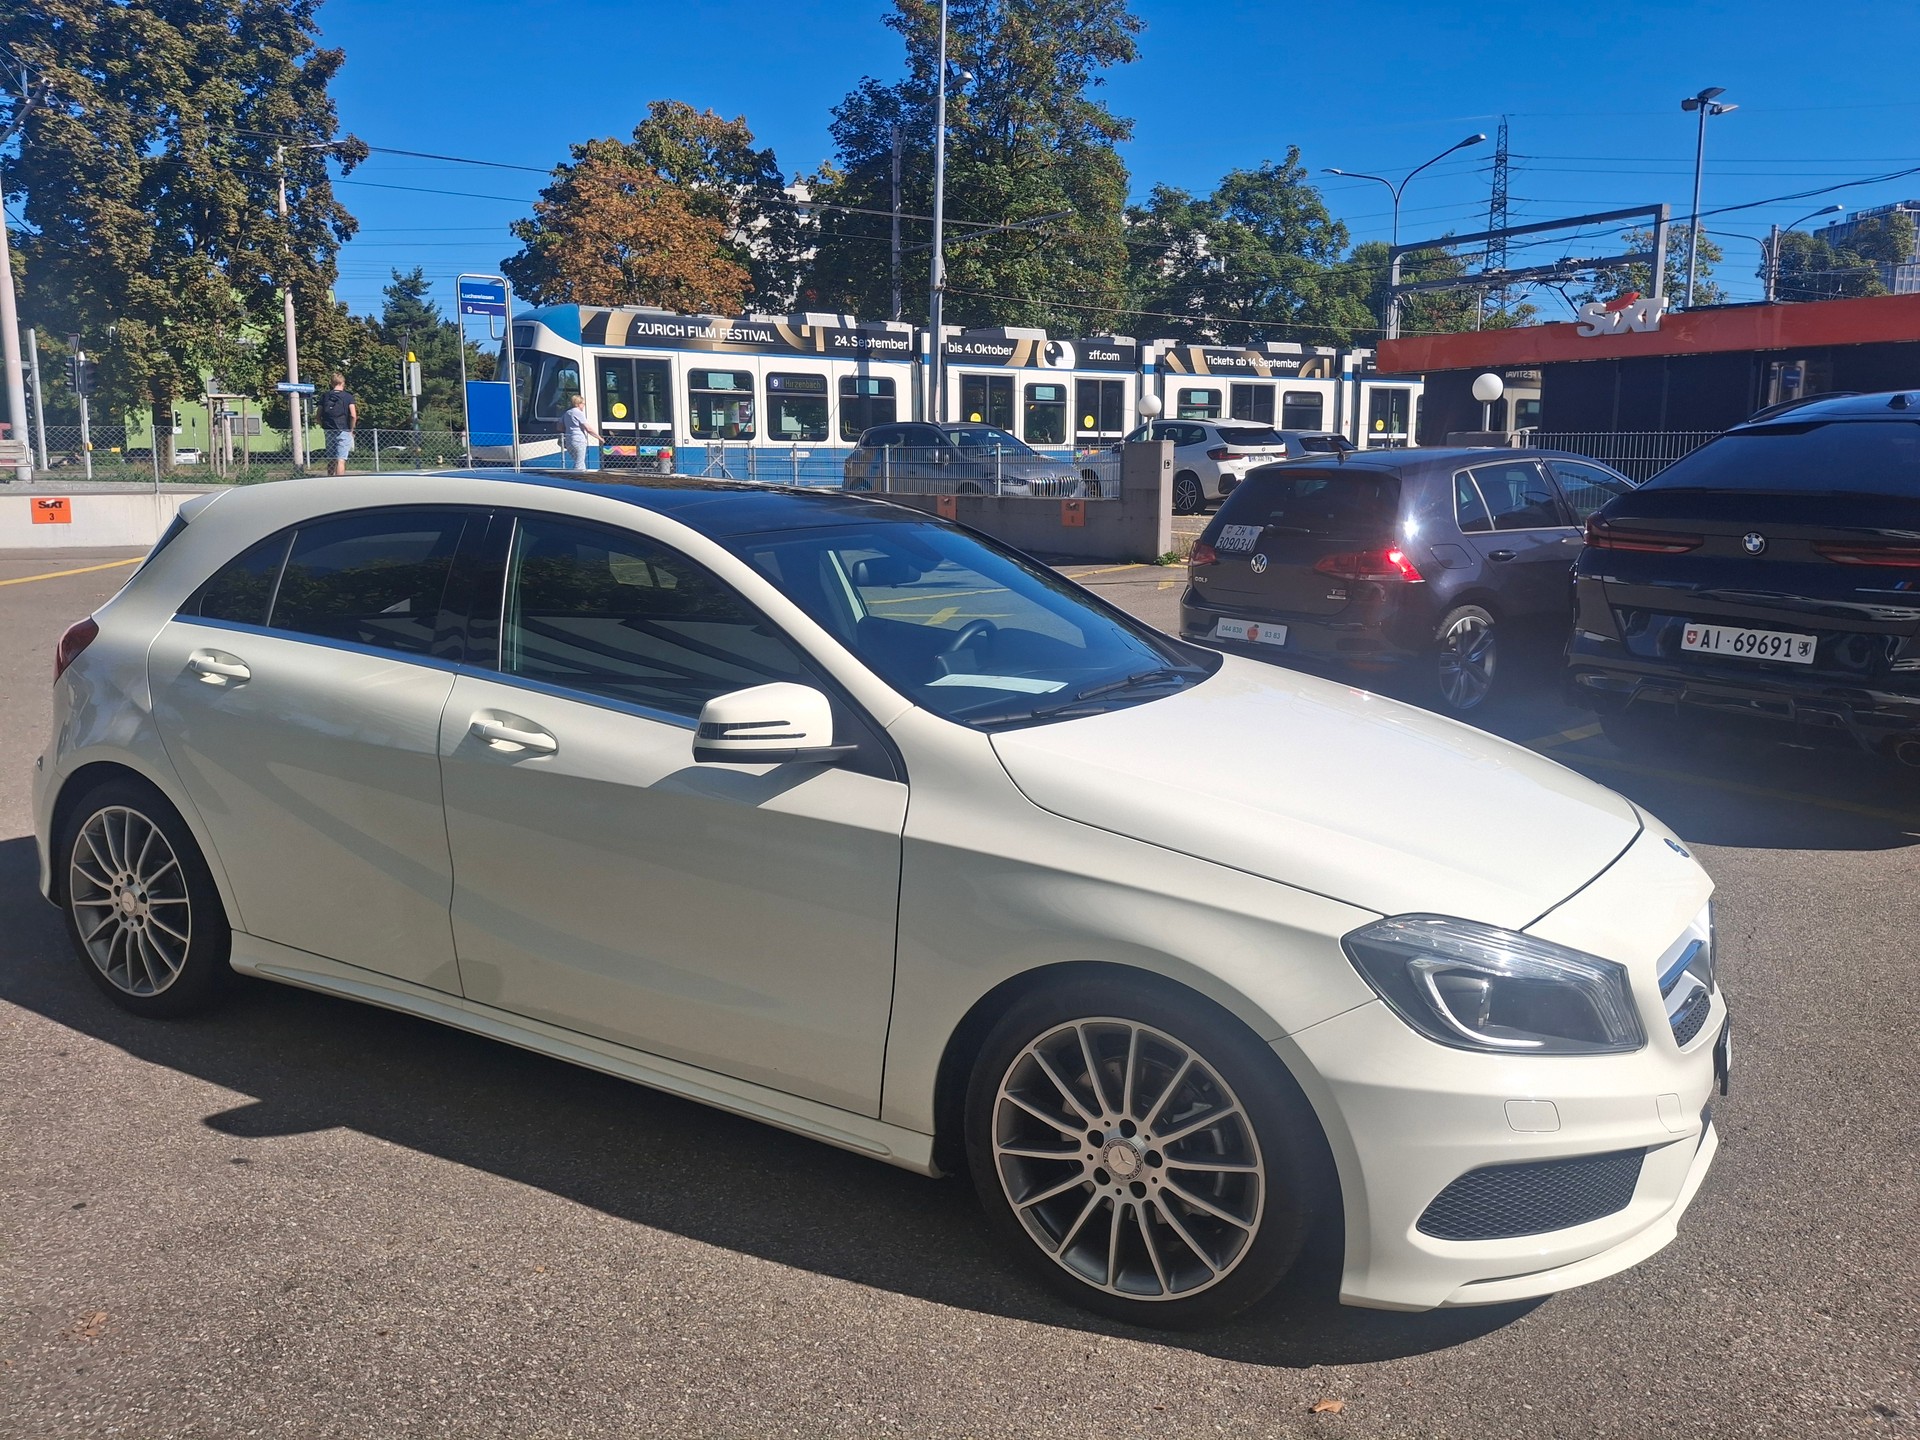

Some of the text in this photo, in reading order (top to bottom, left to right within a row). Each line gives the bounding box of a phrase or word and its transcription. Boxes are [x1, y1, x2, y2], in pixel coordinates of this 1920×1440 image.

[466, 305, 473, 314] 9
[637, 322, 775, 343] ZURICH FILM FESTIVAL
[948, 342, 963, 353] bis
[1088, 350, 1121, 362] zff.com
[1206, 355, 1235, 366] Tickets
[1236, 356, 1247, 367] ab
[773, 379, 780, 388] 9
[49, 512, 55, 521] 3
[1235, 526, 1247, 536] ZH
[1221, 625, 1232, 633] 044
